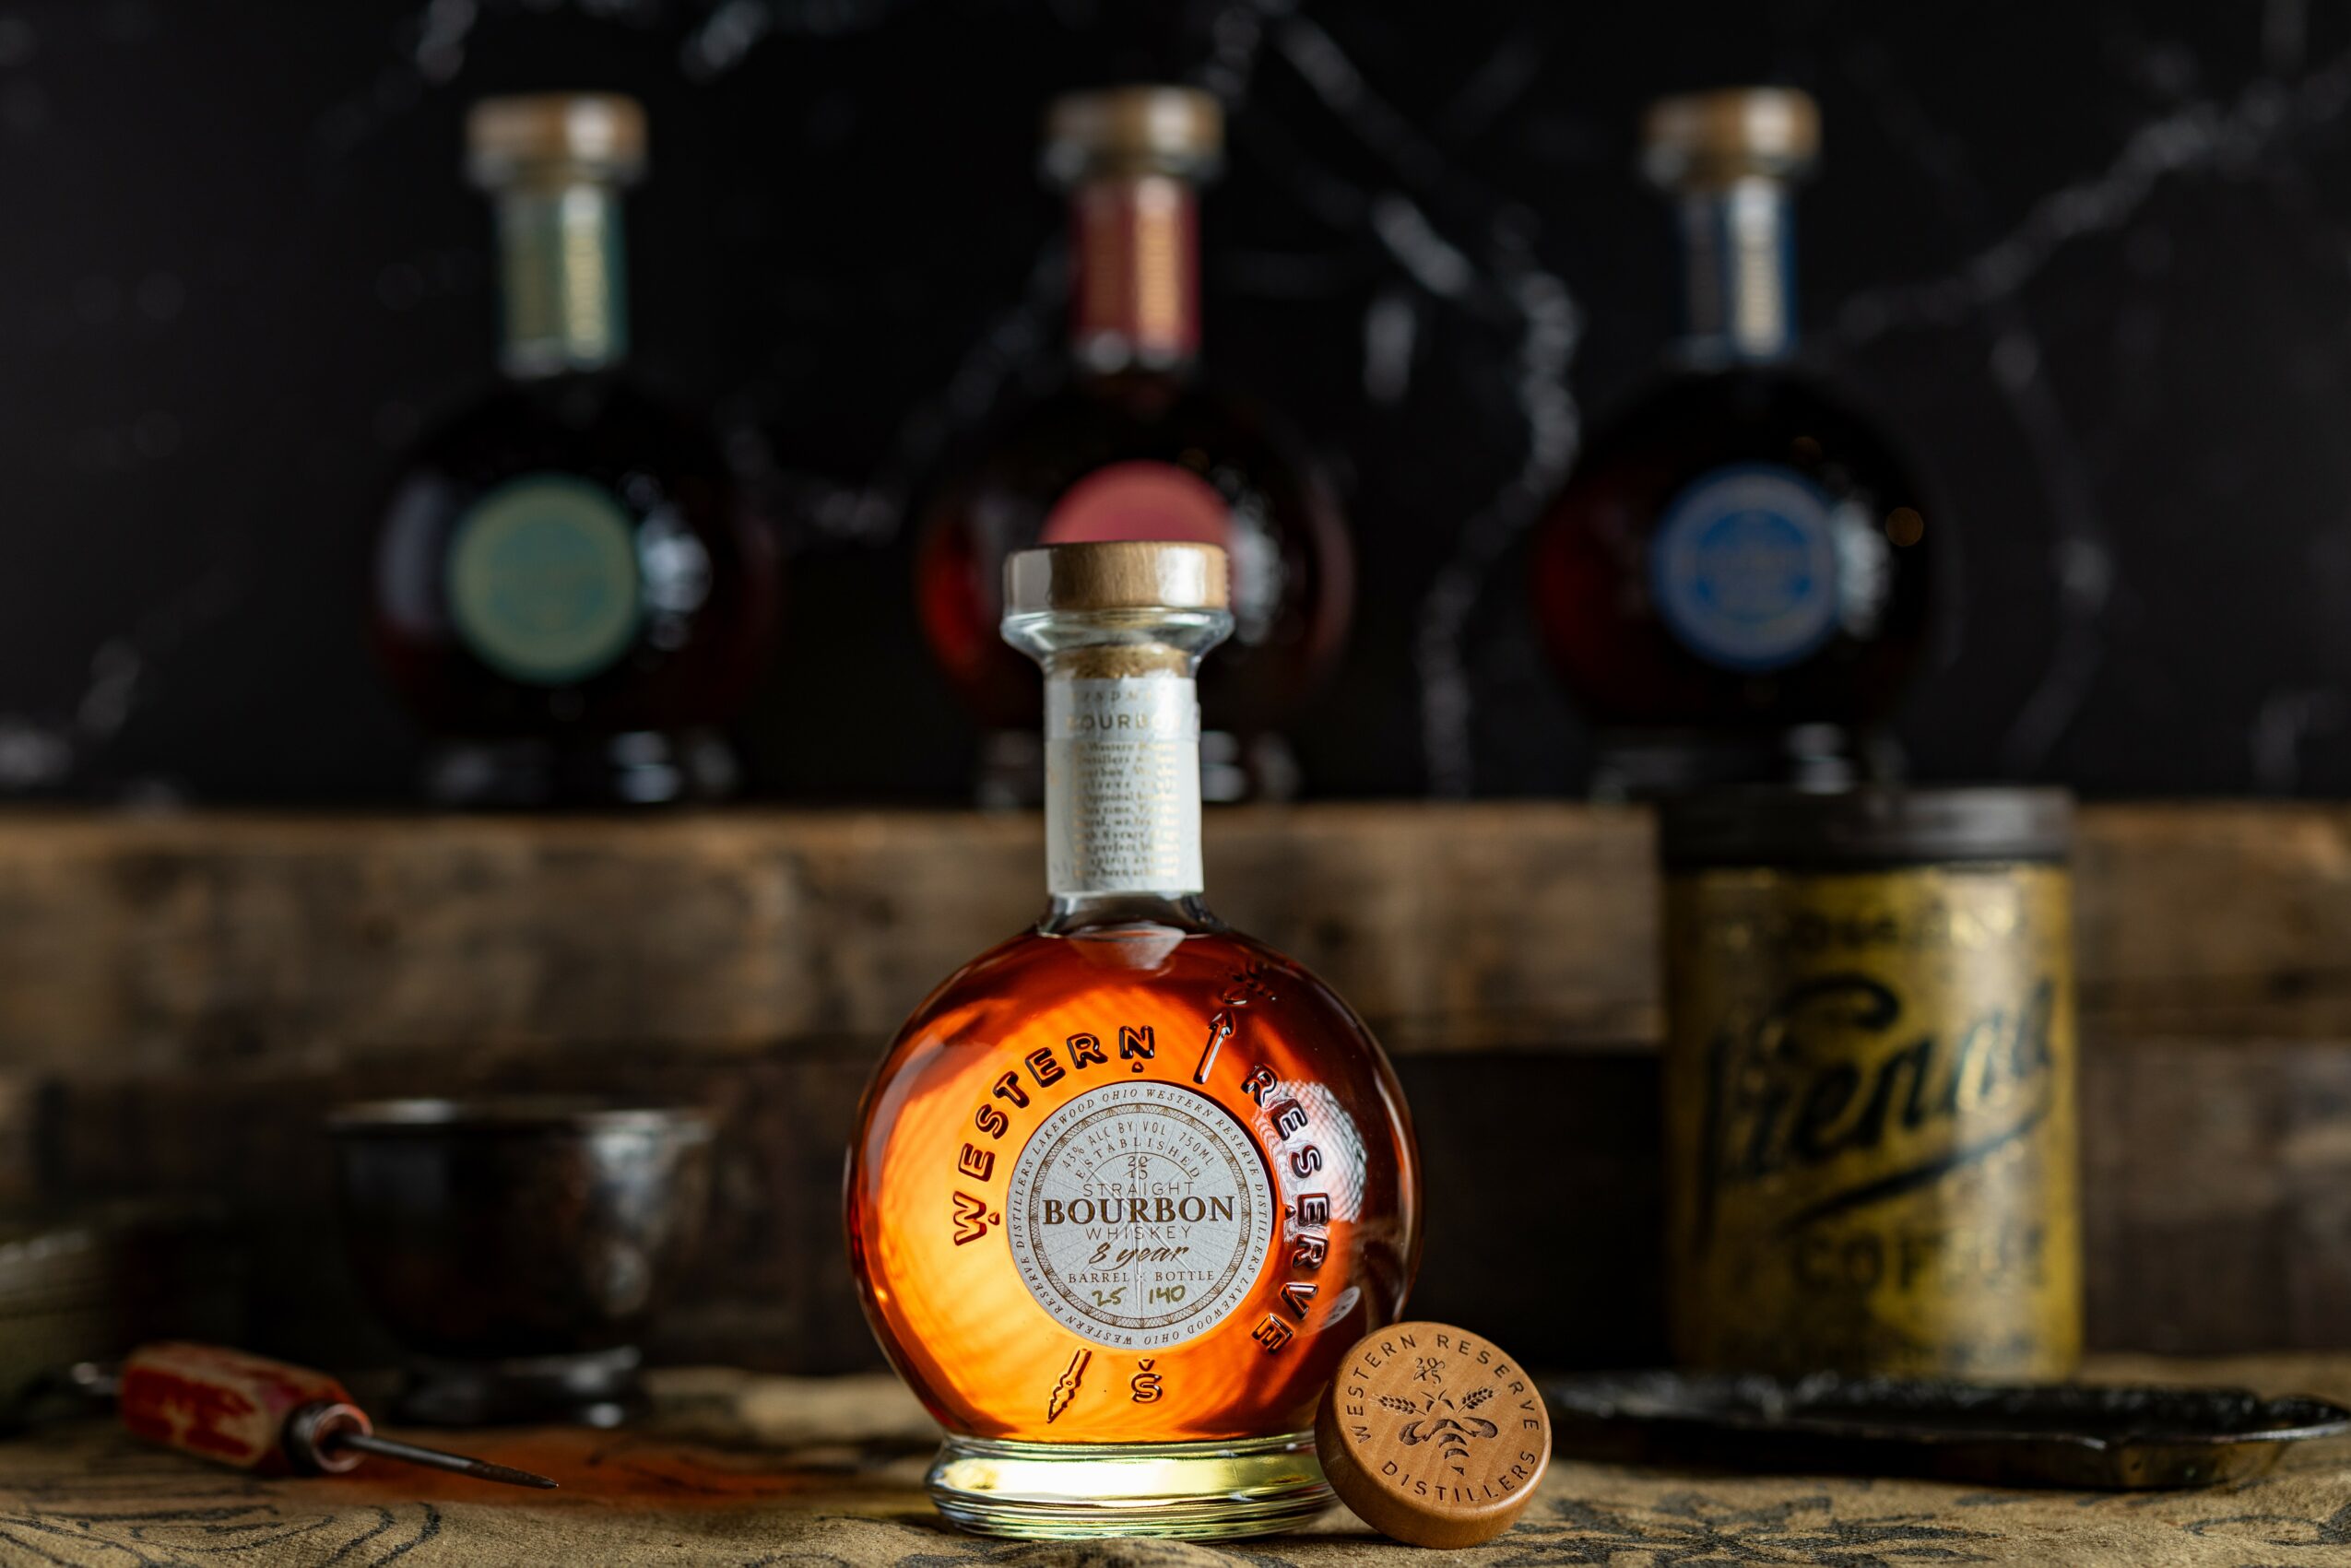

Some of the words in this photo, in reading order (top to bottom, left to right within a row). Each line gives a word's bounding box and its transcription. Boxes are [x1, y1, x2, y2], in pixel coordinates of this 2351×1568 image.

[1102, 1089, 1139, 1103] OHIO
[1146, 1088, 1213, 1117] WESTERN
[1033, 1098, 1095, 1155] LAKEWOOD
[1062, 1146, 1085, 1169] 43%
[1087, 1126, 1111, 1147] ALC
[1117, 1121, 1133, 1134] BY
[1142, 1120, 1166, 1136] VOL
[1178, 1132, 1216, 1167] 750ML
[1075, 1138, 1200, 1180] ESTABLISHED
[1215, 1118, 1258, 1177] RESERVE
[952, 1025, 1154, 1246] WESTERN
[1241, 1064, 1330, 1355] RESERVE
[1015, 1159, 1034, 1248] DISTILLERS
[1082, 1182, 1195, 1197] STRAIGHT
[1042, 1196, 1235, 1225] BOURBON
[1247, 1184, 1267, 1274] DISTILLERS
[1085, 1225, 1192, 1240] WHISKEY
[1088, 1242, 1111, 1265] 8
[1092, 1245, 1189, 1272] year
[1020, 1256, 1063, 1314] RESERVE
[1069, 1272, 1130, 1284] BARREL
[1155, 1270, 1215, 1282] BOTTLE
[1092, 1286, 1128, 1307] 25
[1149, 1284, 1186, 1304] 140
[1187, 1279, 1249, 1335] LAKEWOOD
[1066, 1314, 1132, 1346] WESTERN
[1143, 1330, 1180, 1345] OHIO
[1347, 1334, 1416, 1444] WESTERN
[1436, 1334, 1540, 1431] RESERVE
[1381, 1450, 1536, 1503] DISTILLERS
